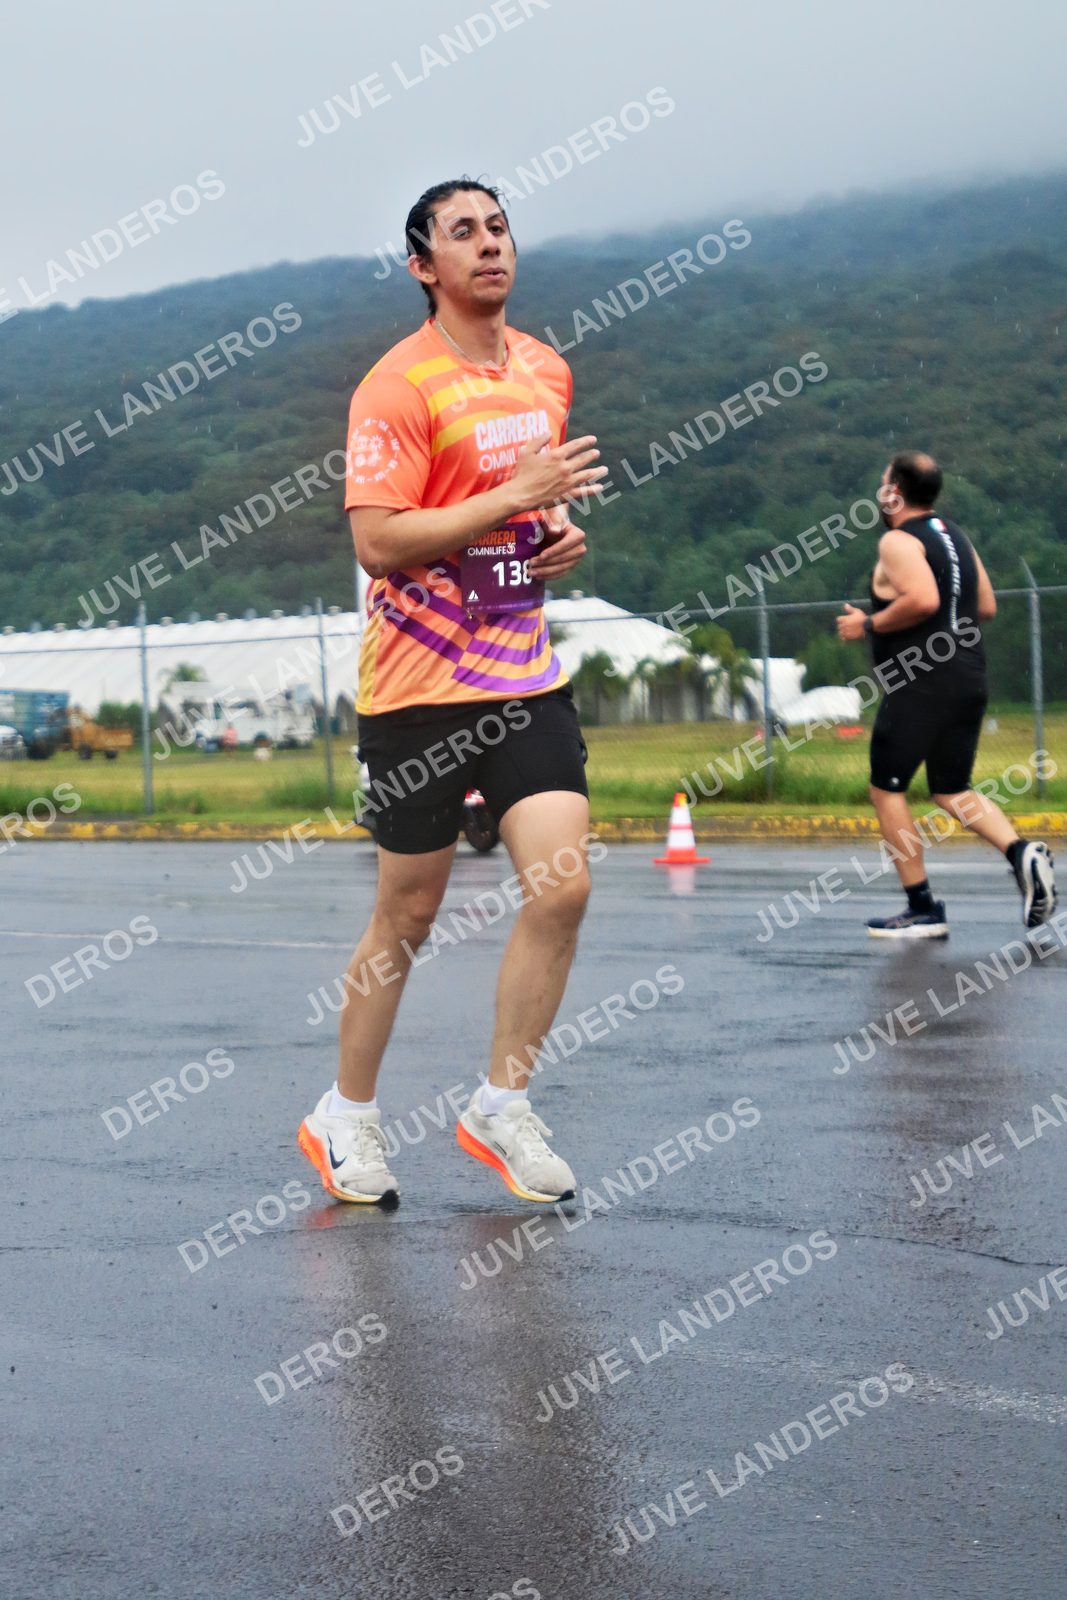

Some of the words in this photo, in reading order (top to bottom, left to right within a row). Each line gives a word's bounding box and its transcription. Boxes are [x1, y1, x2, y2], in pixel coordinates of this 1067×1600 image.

[475, 409, 549, 451] CARRERA
[480, 445, 527, 473] OMNIL
[470, 530, 516, 546] ARRERA
